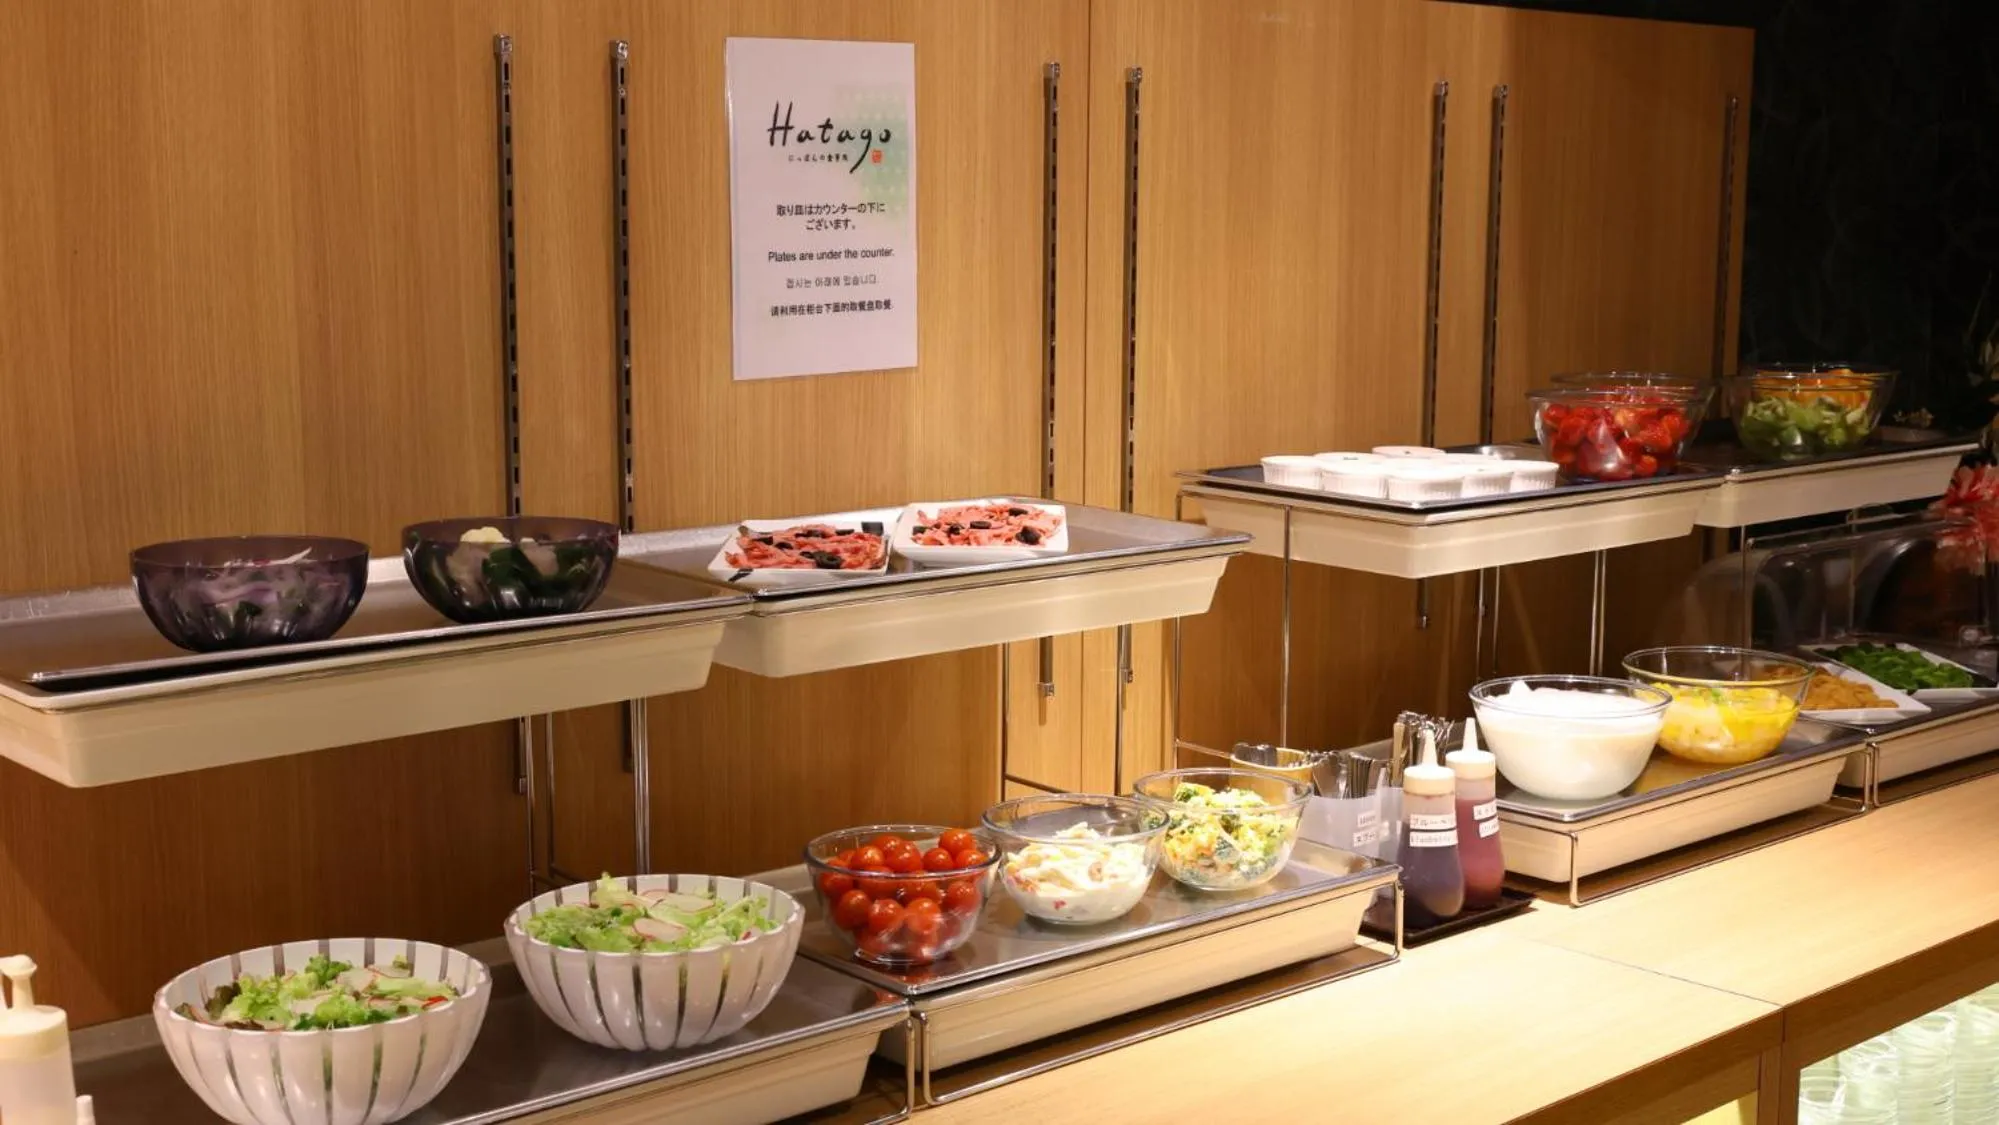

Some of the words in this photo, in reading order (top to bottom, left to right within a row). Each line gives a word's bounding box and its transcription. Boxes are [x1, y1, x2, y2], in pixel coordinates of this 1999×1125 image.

[767, 101, 892, 174] Hatago
[776, 201, 886, 217] 取り皿はカウンターの下に
[805, 218, 857, 231] ございます。
[768, 250, 797, 263] Plates
[799, 252, 814, 261] are
[816, 249, 842, 261] under
[844, 248, 858, 259] the
[860, 247, 895, 259] counter.
